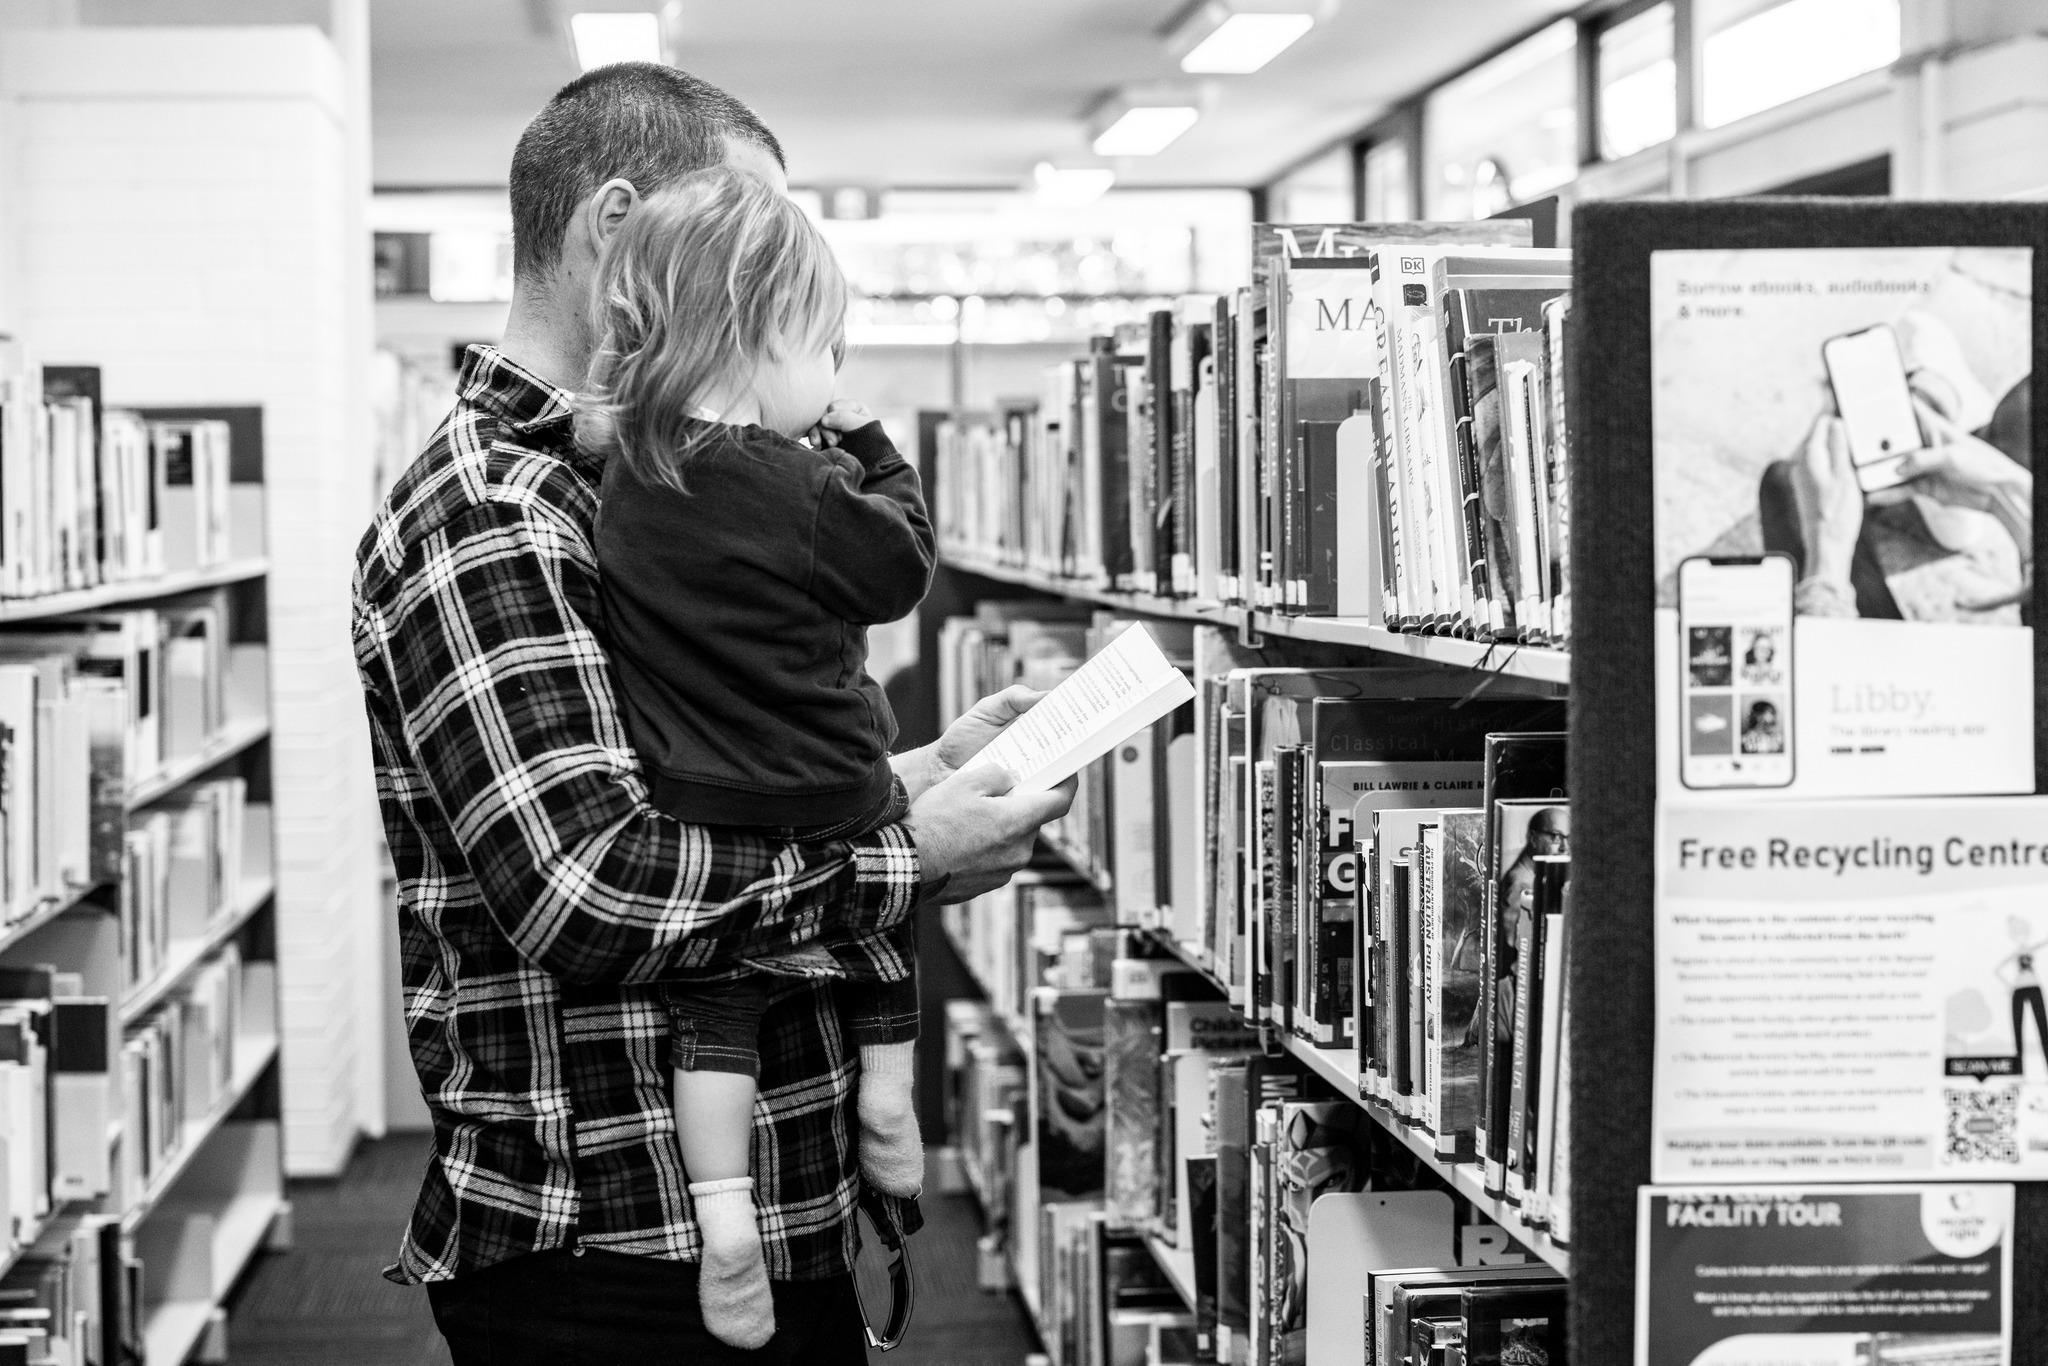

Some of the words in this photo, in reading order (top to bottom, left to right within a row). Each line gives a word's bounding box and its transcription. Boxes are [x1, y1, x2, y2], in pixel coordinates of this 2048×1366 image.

[1404, 261, 1422, 271] DK
[1330, 734, 1428, 752] Classical
[1353, 782, 1375, 791] BILL
[1378, 781, 1418, 791] LAWRIE
[1422, 781, 1430, 790] &
[1434, 780, 1473, 790] CLAIRE
[1678, 837, 1757, 869] Free
[1767, 837, 1934, 876] Recycling
[1666, 1202, 1772, 1227] FACILITY
[1775, 1201, 1843, 1226] TOUR
